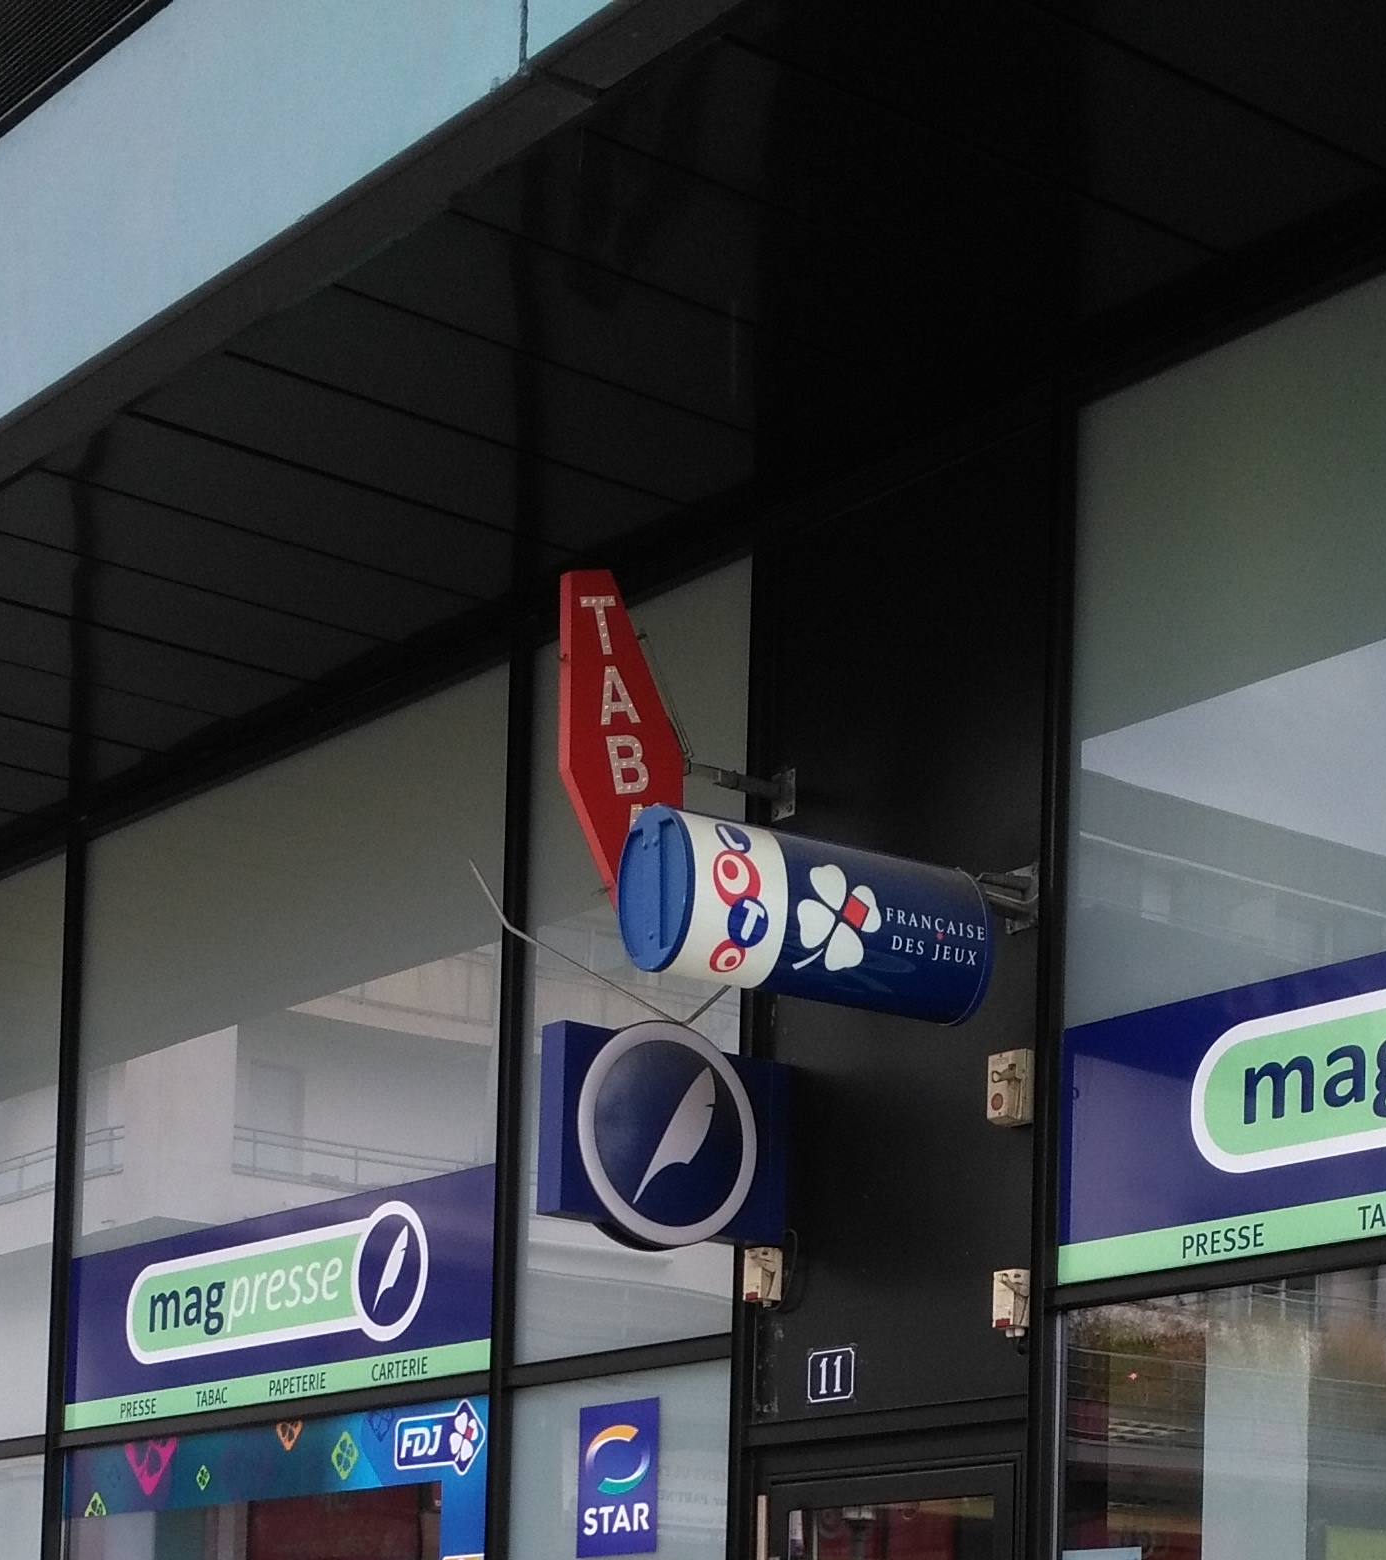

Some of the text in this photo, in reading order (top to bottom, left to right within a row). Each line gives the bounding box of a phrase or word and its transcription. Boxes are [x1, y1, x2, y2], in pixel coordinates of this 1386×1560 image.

[580, 595, 650, 827] TAB
[709, 822, 770, 974] LOTO
[885, 907, 986, 941] FRANÇAISE
[891, 935, 978, 966] DES JEUX
[1180, 1223, 1265, 1259] PRESSE
[148, 1257, 343, 1335] magpresse
[119, 1357, 429, 1419] PRESSE TABAC PAPETERIE CARTERIE
[818, 1355, 843, 1396] 11
[400, 1425, 441, 1458] FDJ
[583, 1502, 650, 1536] STAR
